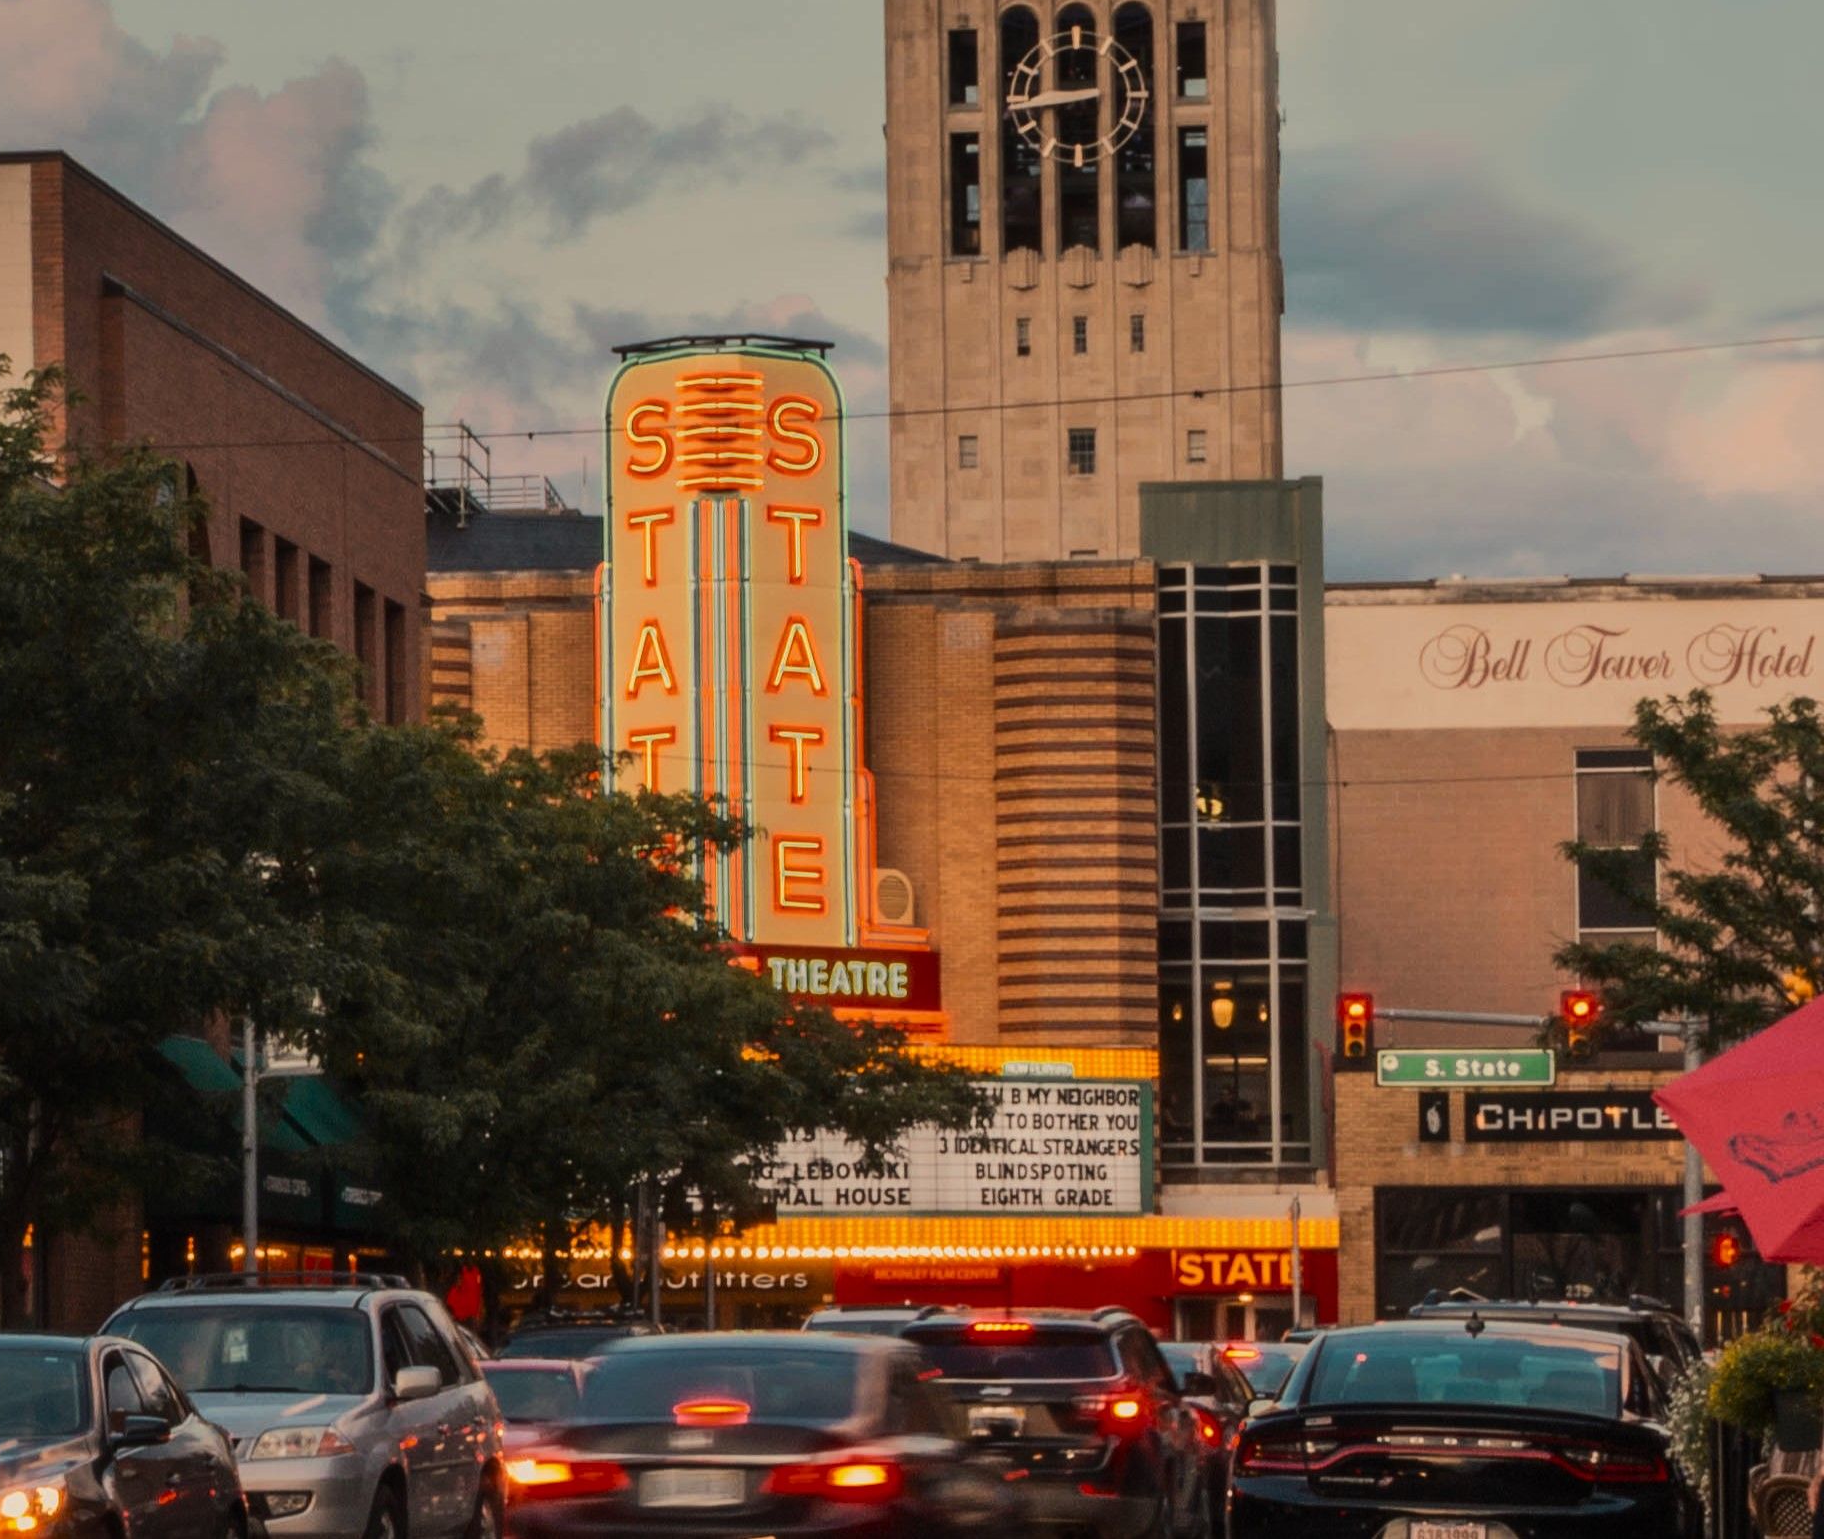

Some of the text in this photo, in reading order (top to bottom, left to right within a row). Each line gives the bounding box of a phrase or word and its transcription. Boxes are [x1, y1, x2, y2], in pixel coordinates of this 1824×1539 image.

[622, 395, 678, 796] STAT
[763, 395, 827, 914] STATE
[1419, 623, 1815, 690] Bell Tower Hotel
[767, 954, 909, 999] THEATRE
[1424, 1058, 1521, 1078] S. State
[1011, 1089, 1022, 1105] B
[1027, 1088, 1052, 1106] MY
[1057, 1088, 1140, 1107] NEIGHBOR
[1006, 1113, 1028, 1130] TO
[1032, 1113, 1099, 1131] BOTHER
[1106, 1114, 1138, 1132] YOU
[1474, 1103, 1679, 1131] CHIPOTLE
[954, 1137, 1040, 1155] IDENTICAL
[1042, 1138, 1140, 1156] STRANGERS
[793, 1162, 910, 1181] LEBOWSKI
[976, 1163, 1108, 1181] BLINDSPOTING
[836, 1187, 912, 1206] HOUSE
[981, 1187, 1113, 1207] EIGHTH GRADE
[660, 1271, 809, 1289] utitters
[1178, 1253, 1305, 1287] STATE
